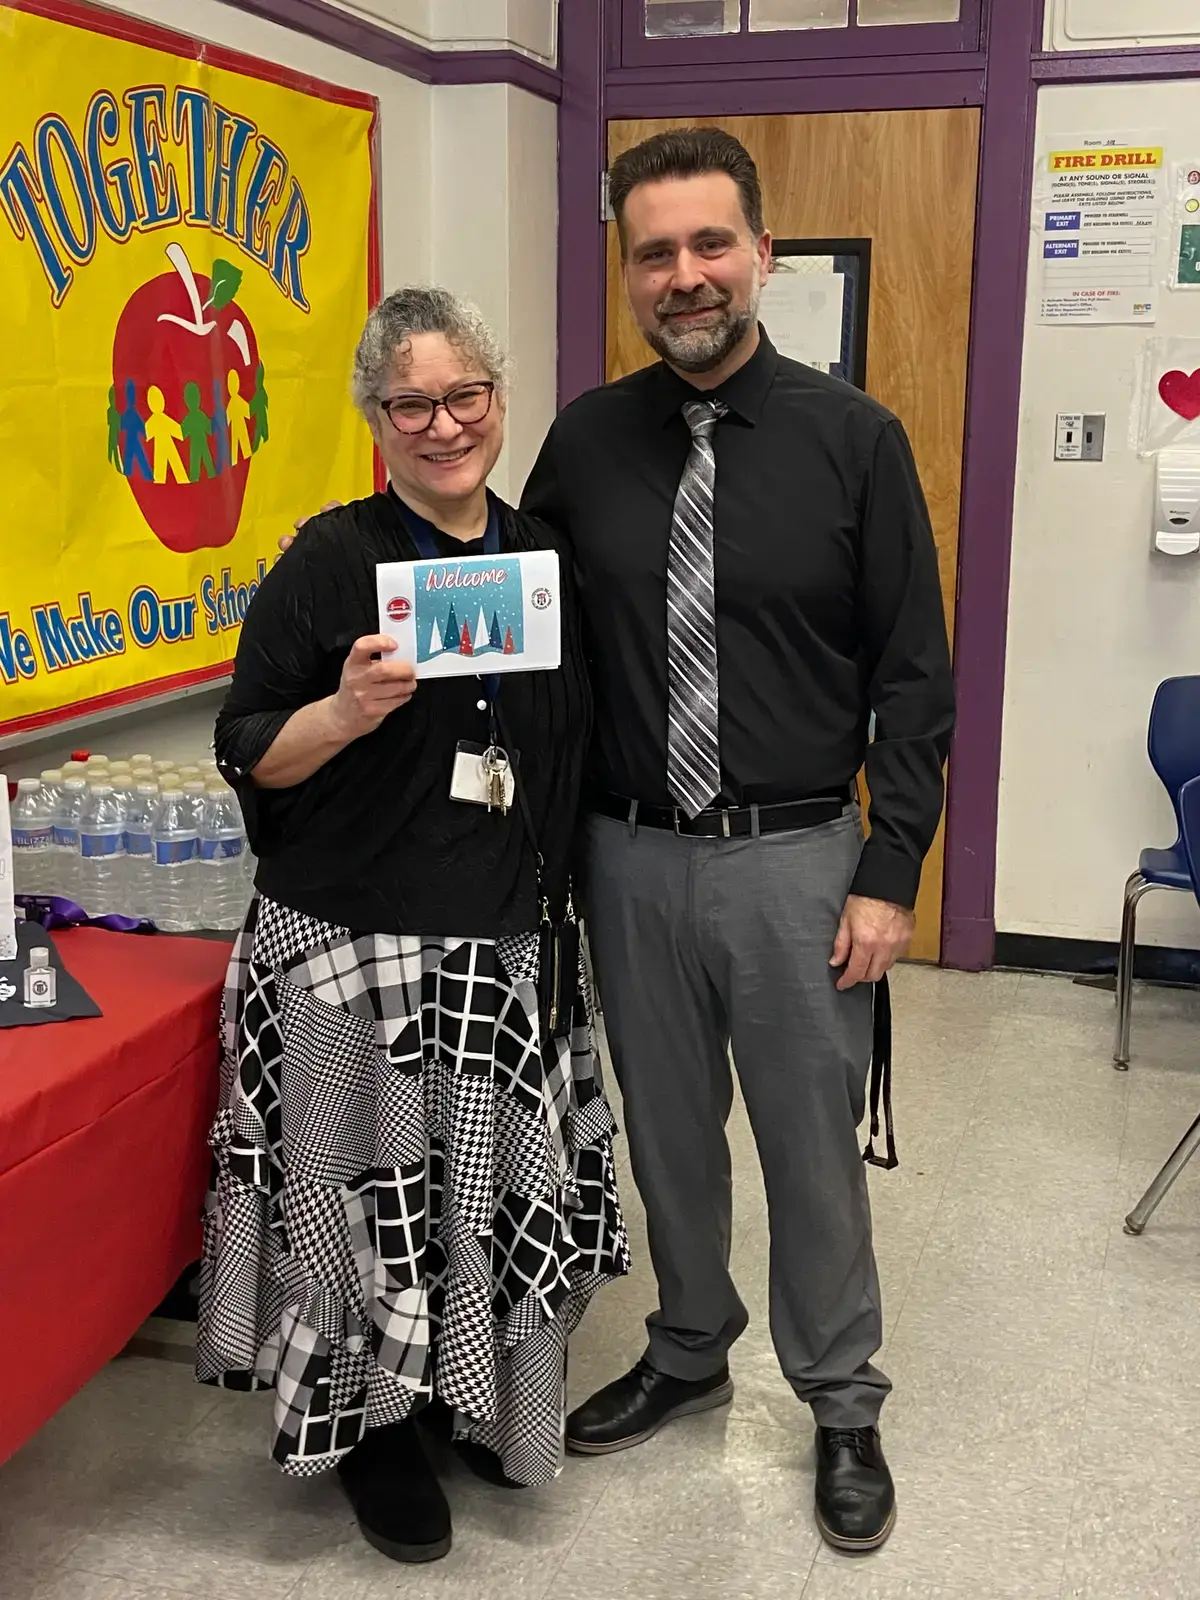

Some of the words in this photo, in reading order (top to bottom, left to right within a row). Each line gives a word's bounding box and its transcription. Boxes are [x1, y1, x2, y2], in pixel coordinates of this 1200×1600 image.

[1054, 155, 1096, 168] FIRE
[1100, 153, 1156, 166] DRILL
[0, 84, 311, 313] TOGETHER
[425, 565, 506, 592] Welcome
[31, 592, 126, 674] Make
[128, 585, 198, 649] Our
